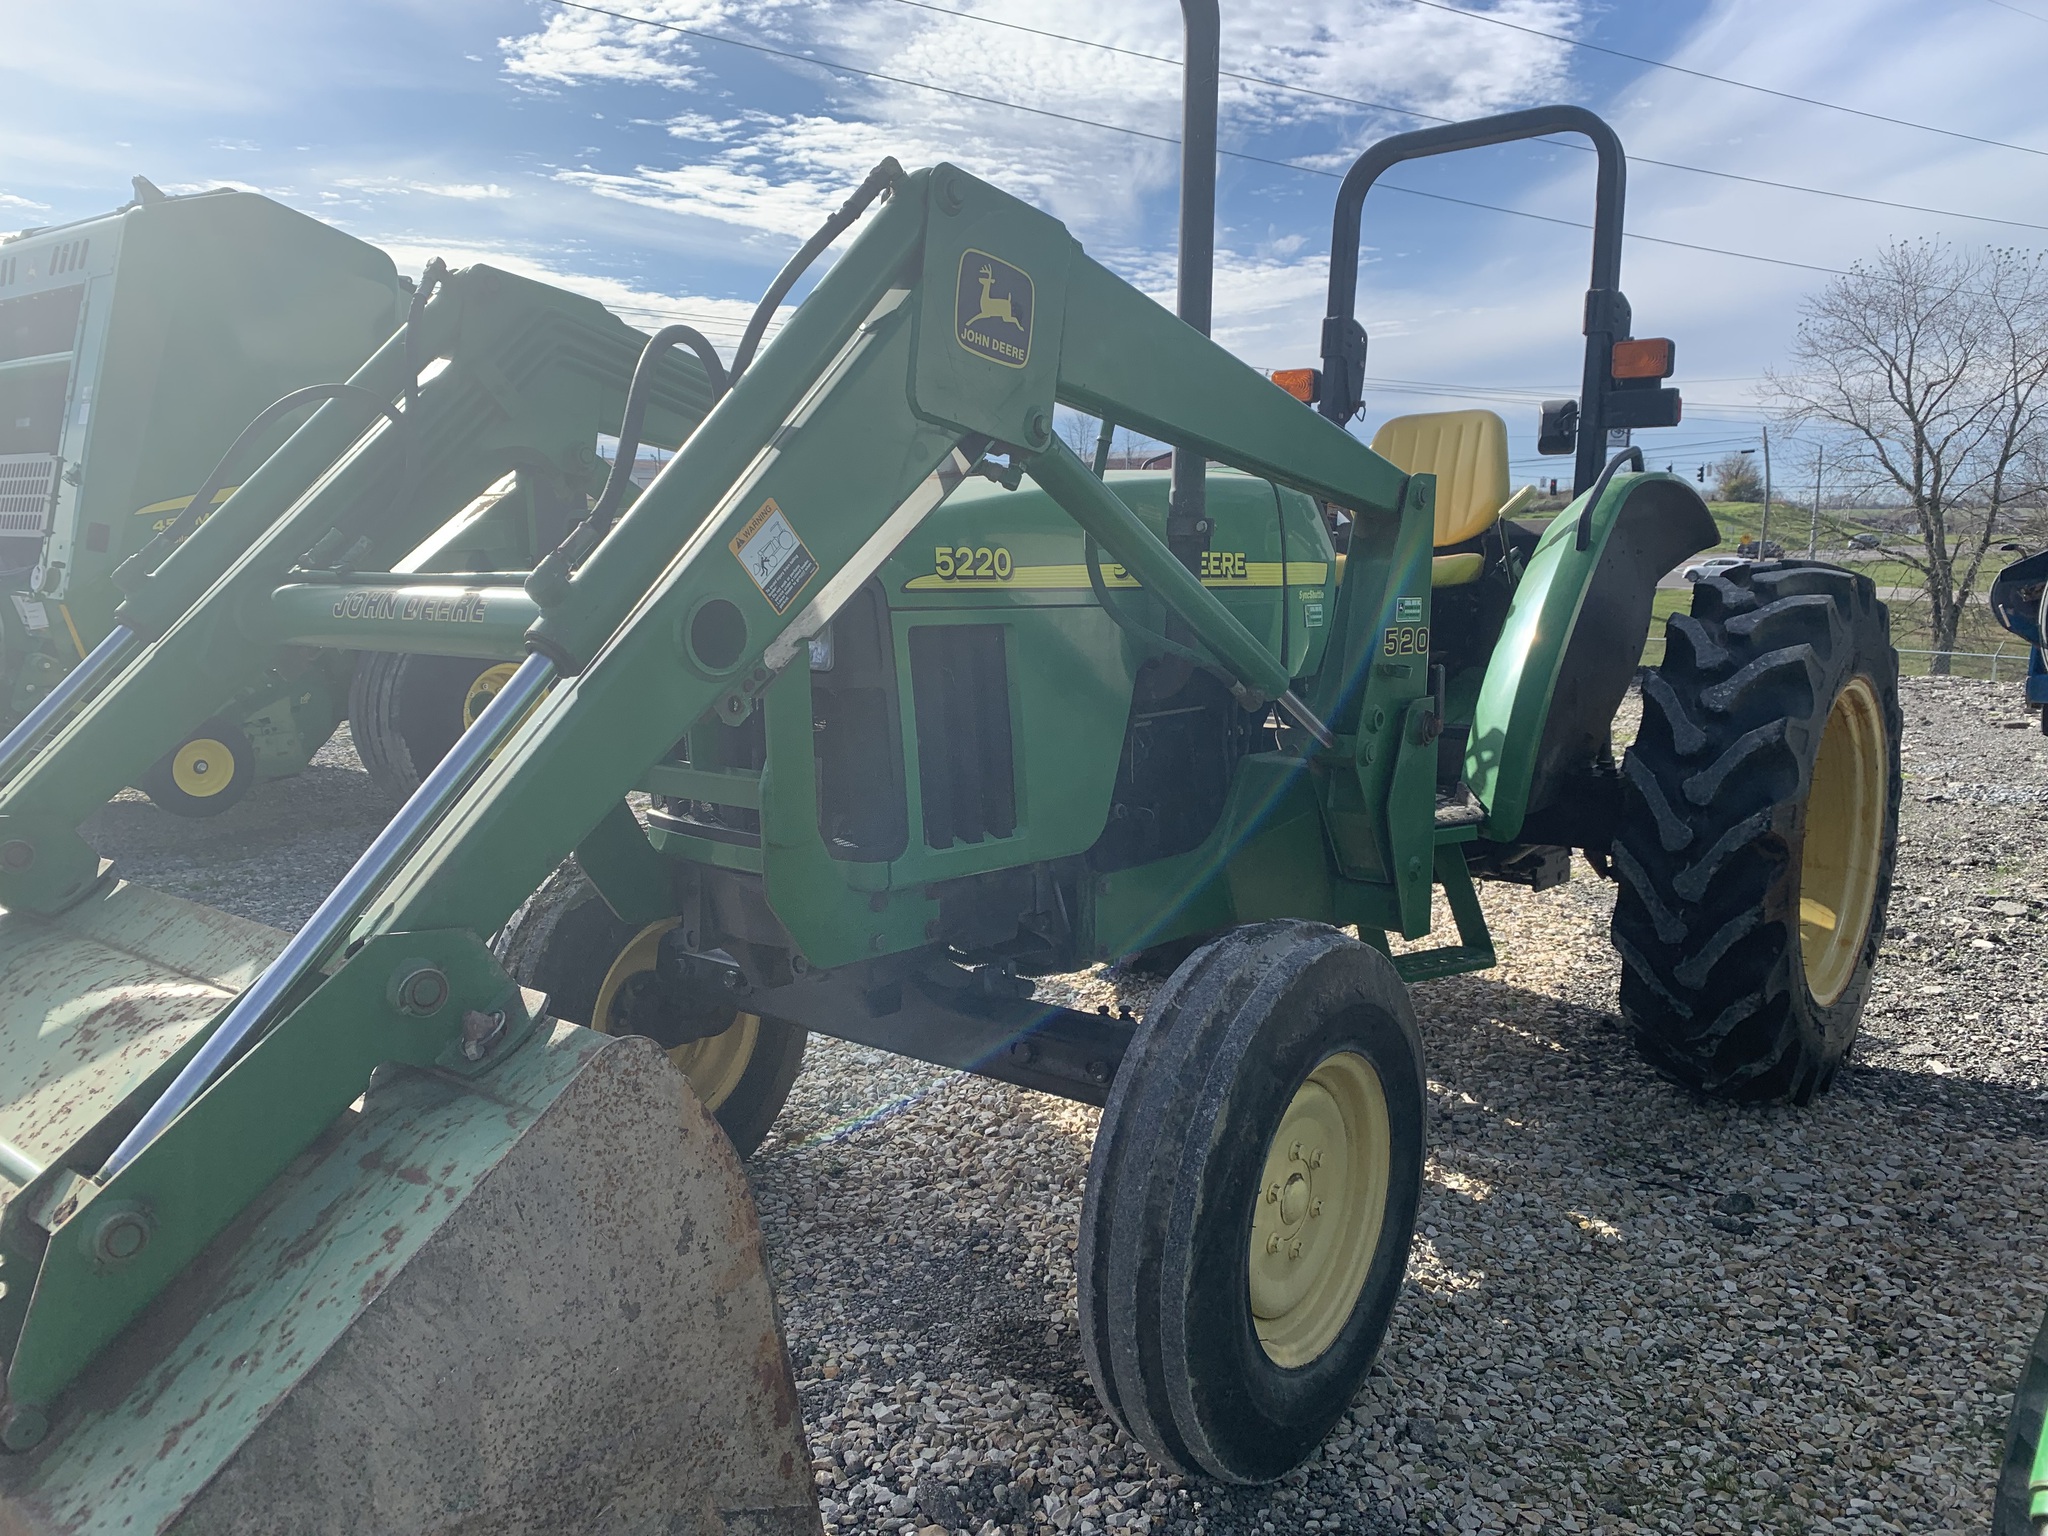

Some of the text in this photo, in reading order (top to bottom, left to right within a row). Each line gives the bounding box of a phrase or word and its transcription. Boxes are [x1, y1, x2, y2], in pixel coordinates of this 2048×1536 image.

[961, 328, 1025, 361] JOHN DEERE
[743, 505, 772, 538] WARNING
[935, 547, 1014, 580] 5220
[1201, 551, 1247, 578] EERE
[333, 591, 488, 623] JOHN DEERE
[1383, 626, 1430, 657] 520
